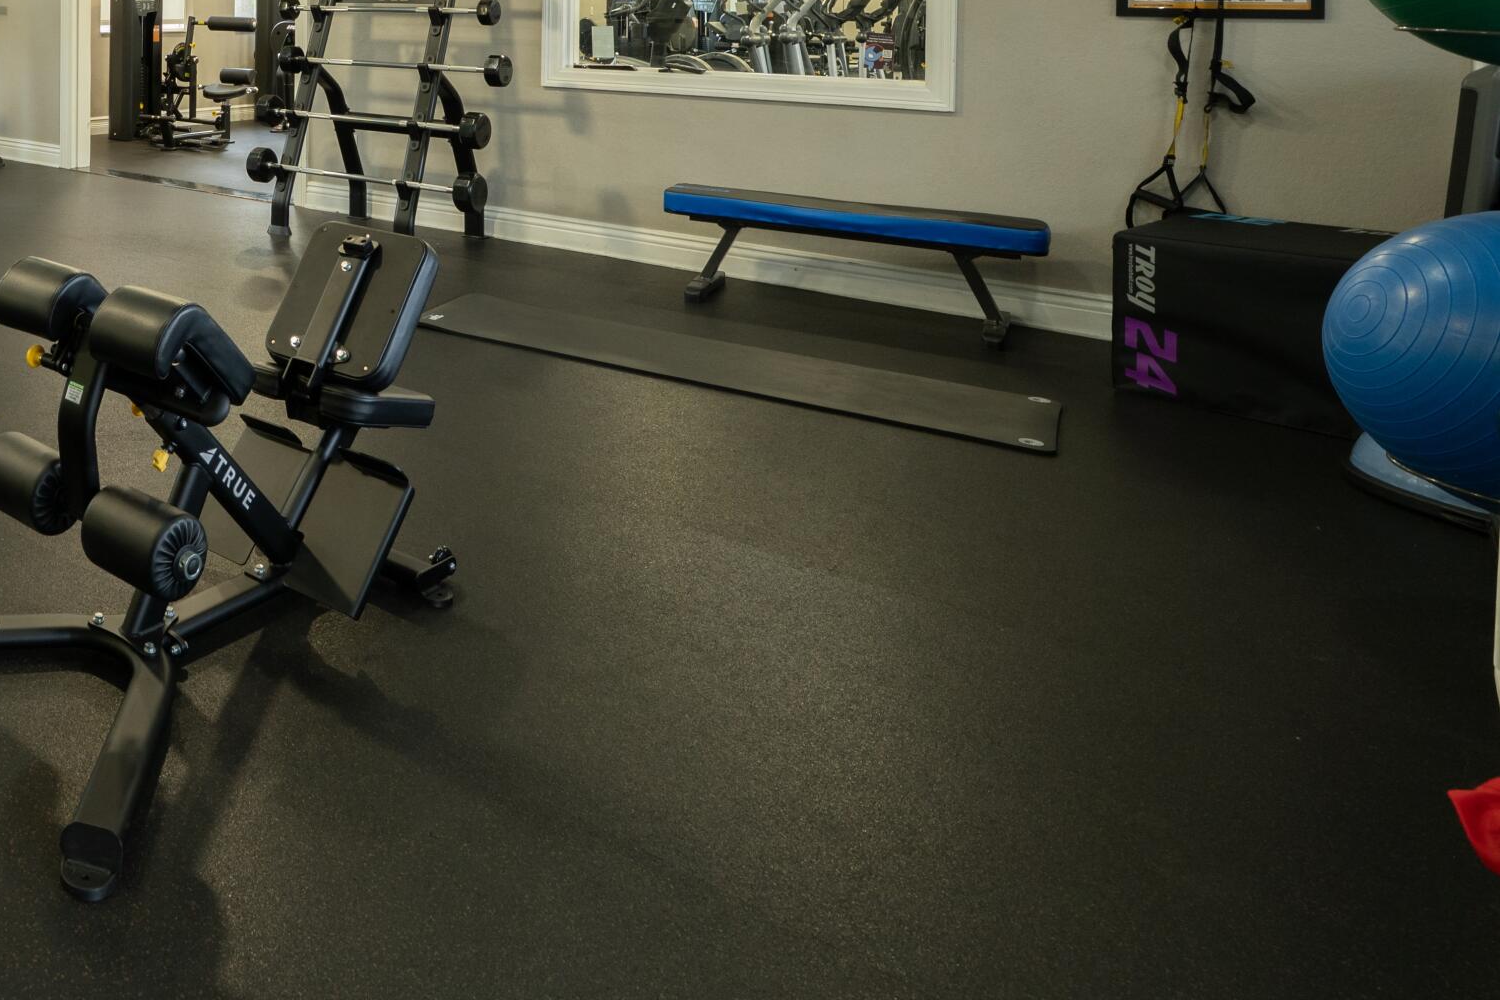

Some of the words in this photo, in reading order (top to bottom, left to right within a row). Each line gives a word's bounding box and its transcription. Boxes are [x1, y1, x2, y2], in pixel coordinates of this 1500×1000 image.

[1126, 244, 1156, 314] TROY
[1124, 315, 1178, 395] 24
[214, 453, 256, 511] TRUE
